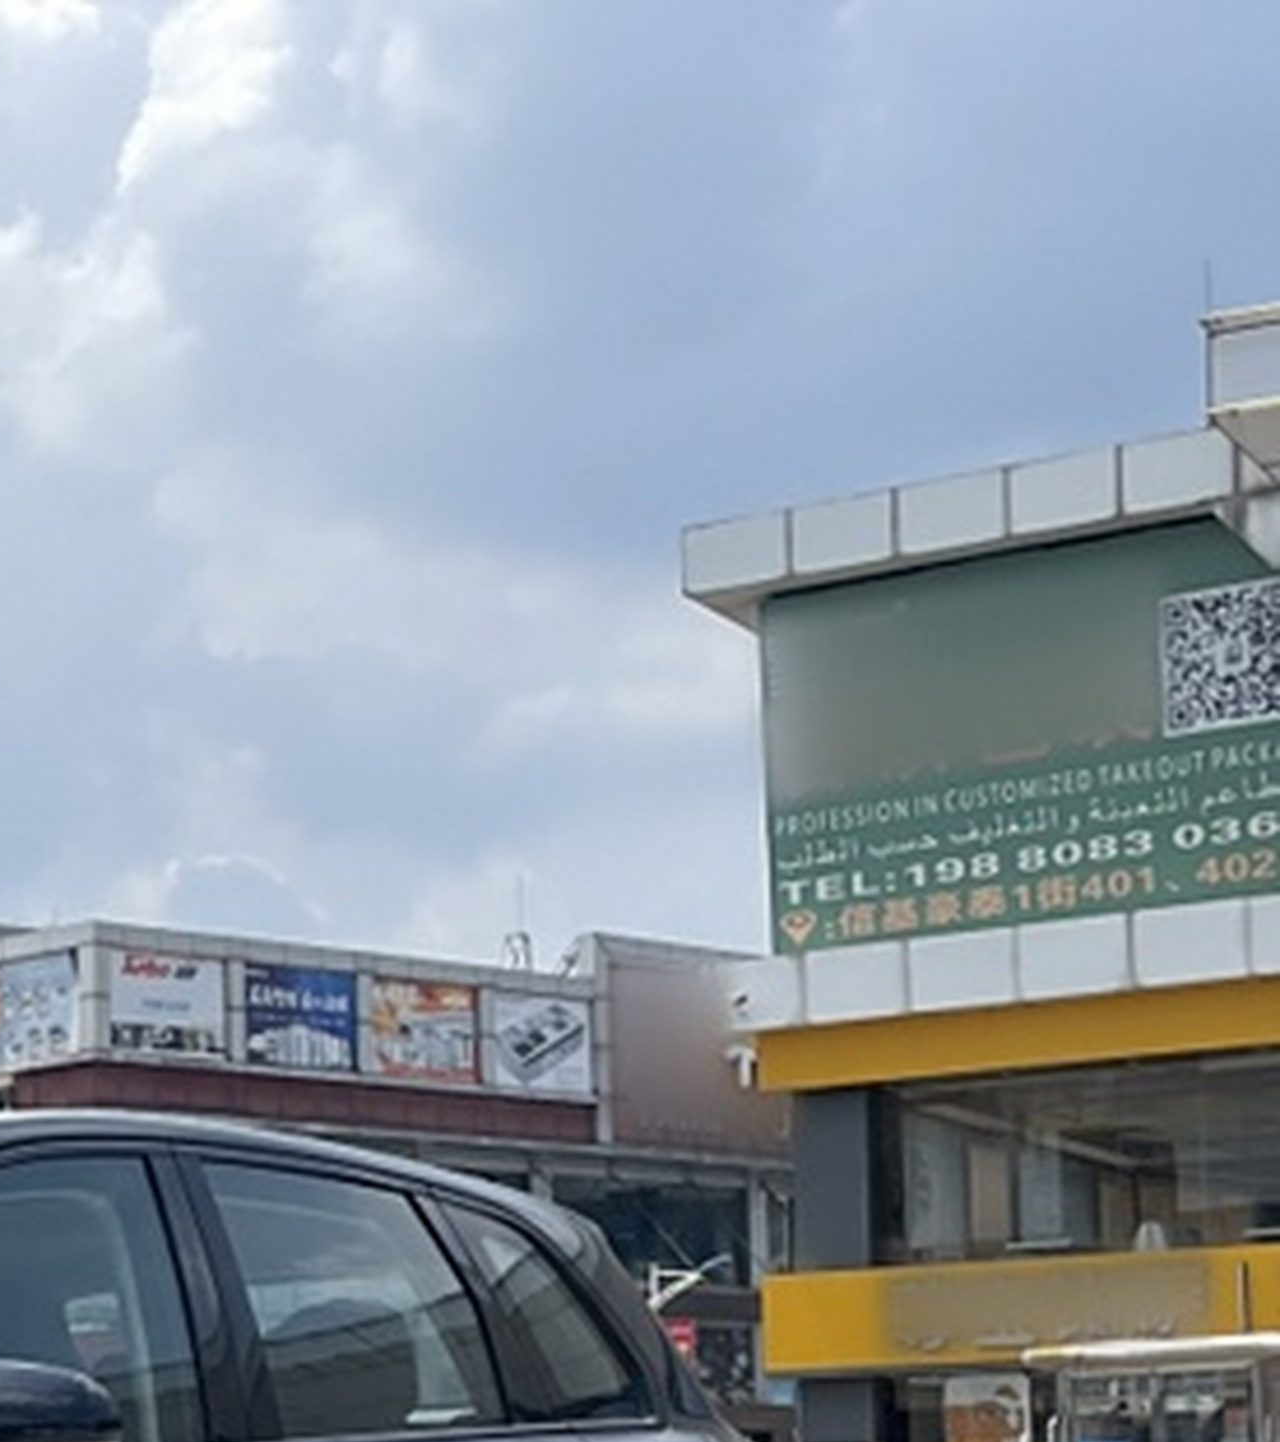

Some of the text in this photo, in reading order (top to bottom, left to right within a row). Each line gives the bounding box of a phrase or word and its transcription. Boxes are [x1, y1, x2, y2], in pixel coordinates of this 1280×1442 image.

[775, 797, 910, 835] PROFESSION
[912, 793, 938, 816] IN
[944, 768, 1092, 812] CUSTOMIZED
[1098, 751, 1205, 786] TAKEOUT
[1017, 829, 1154, 874] 8083
[1172, 810, 1280, 850] 036
